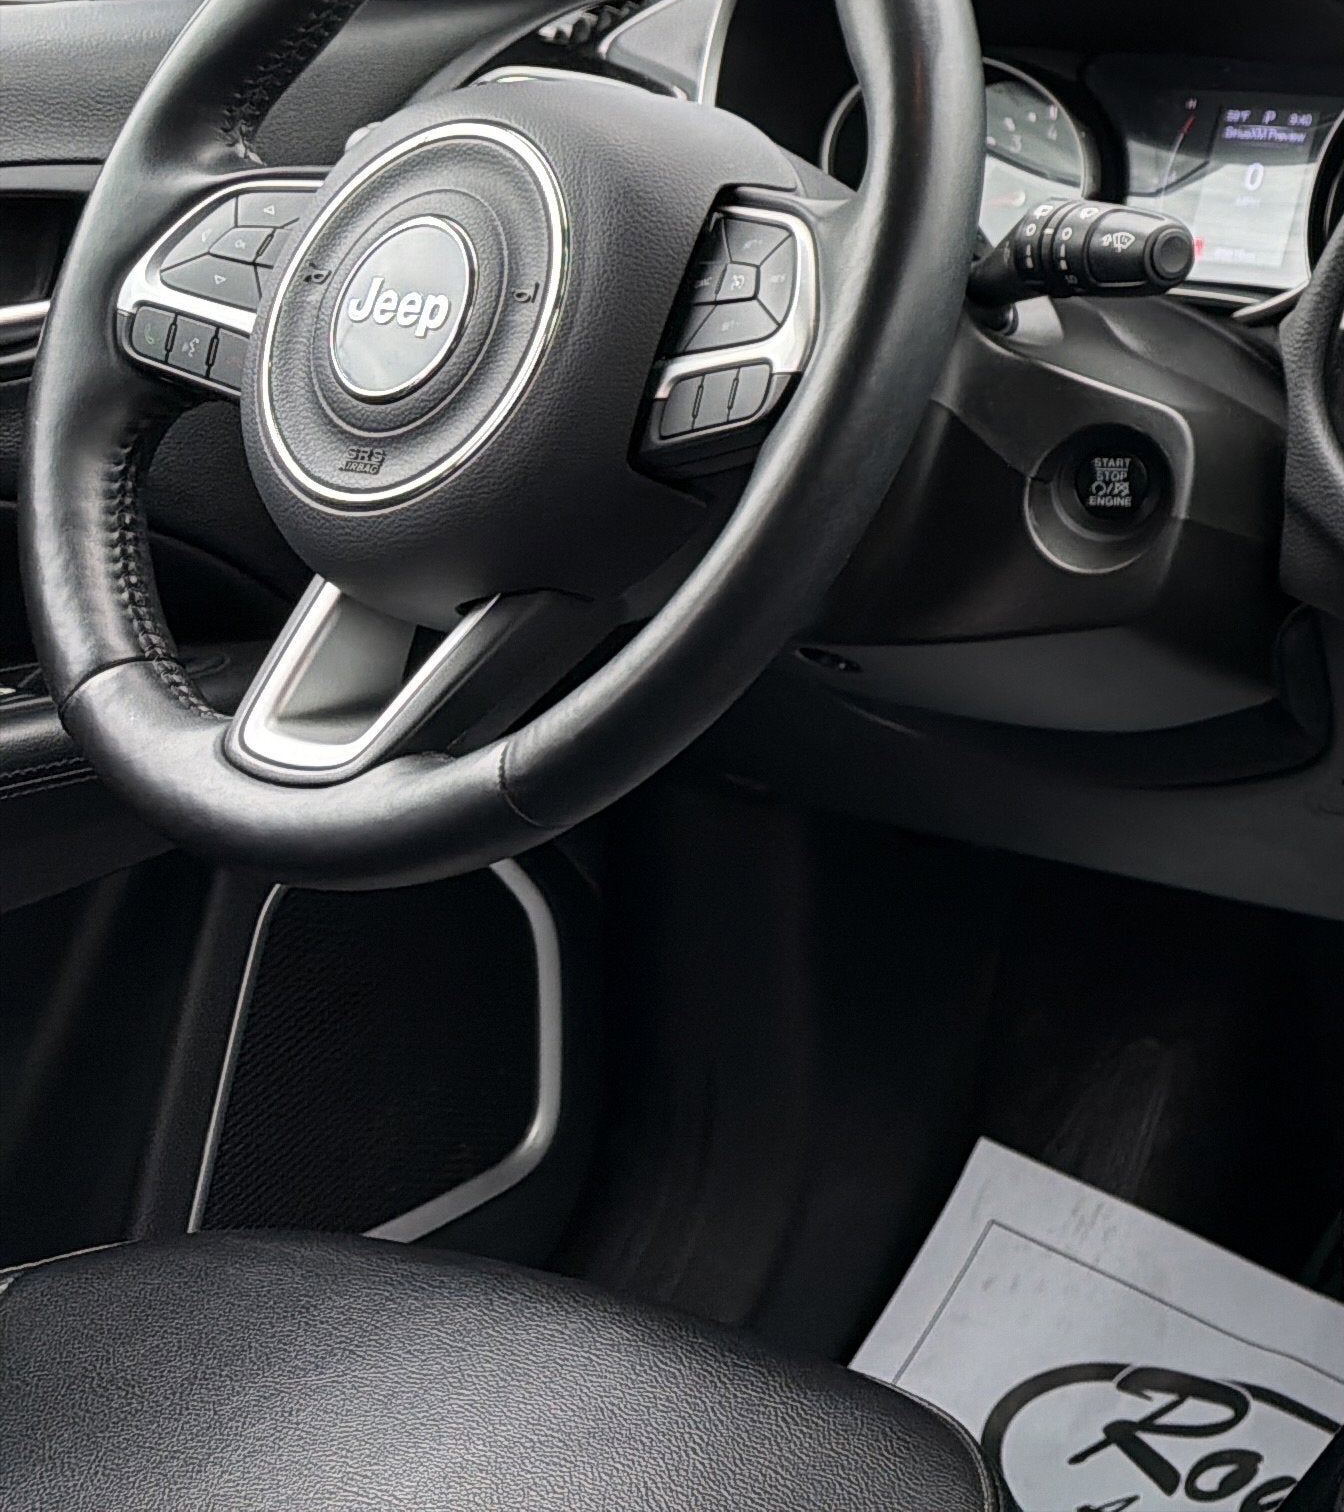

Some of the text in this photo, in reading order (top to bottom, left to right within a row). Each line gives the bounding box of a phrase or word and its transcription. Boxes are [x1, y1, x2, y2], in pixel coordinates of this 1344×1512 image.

[348, 277, 450, 337] Jeep
[346, 447, 386, 463] SRS
[339, 461, 380, 475] AIRBAG
[1094, 458, 1131, 468] START
[1096, 471, 1128, 482] STOP
[1089, 496, 1132, 507] ENGINE
